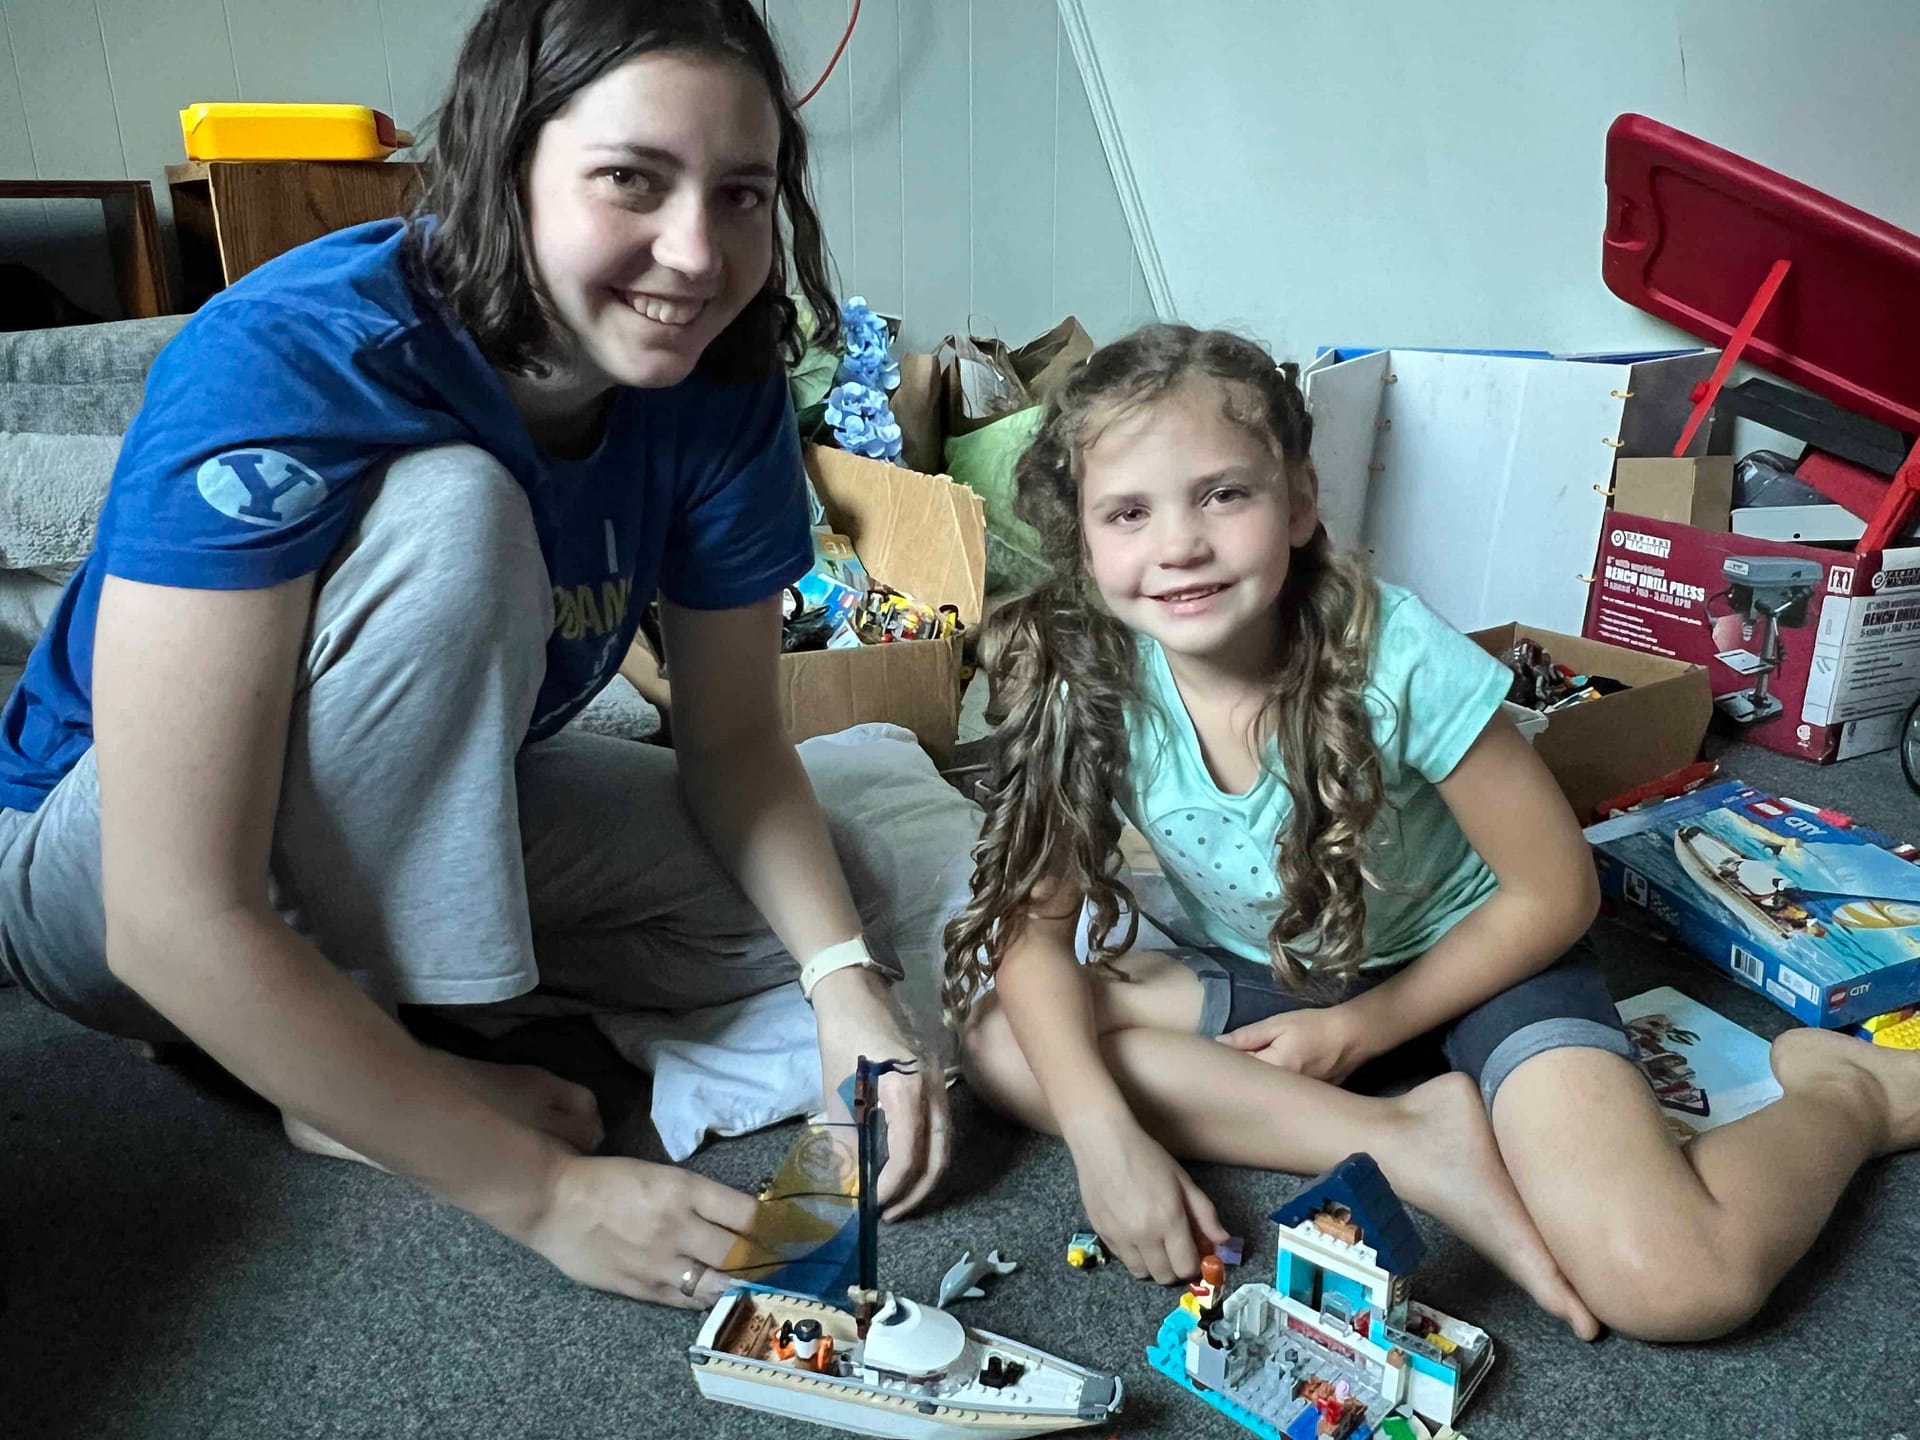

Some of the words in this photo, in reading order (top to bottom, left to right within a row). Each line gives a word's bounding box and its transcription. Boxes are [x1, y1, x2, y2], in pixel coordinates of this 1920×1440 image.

[219, 453, 316, 522] Y
[1605, 565, 1638, 585] BENCH
[1639, 574, 1668, 593] DRILL
[1669, 581, 1705, 602] PRESS
[1784, 816, 1828, 836] CITY
[1850, 982, 1872, 996] CITY
